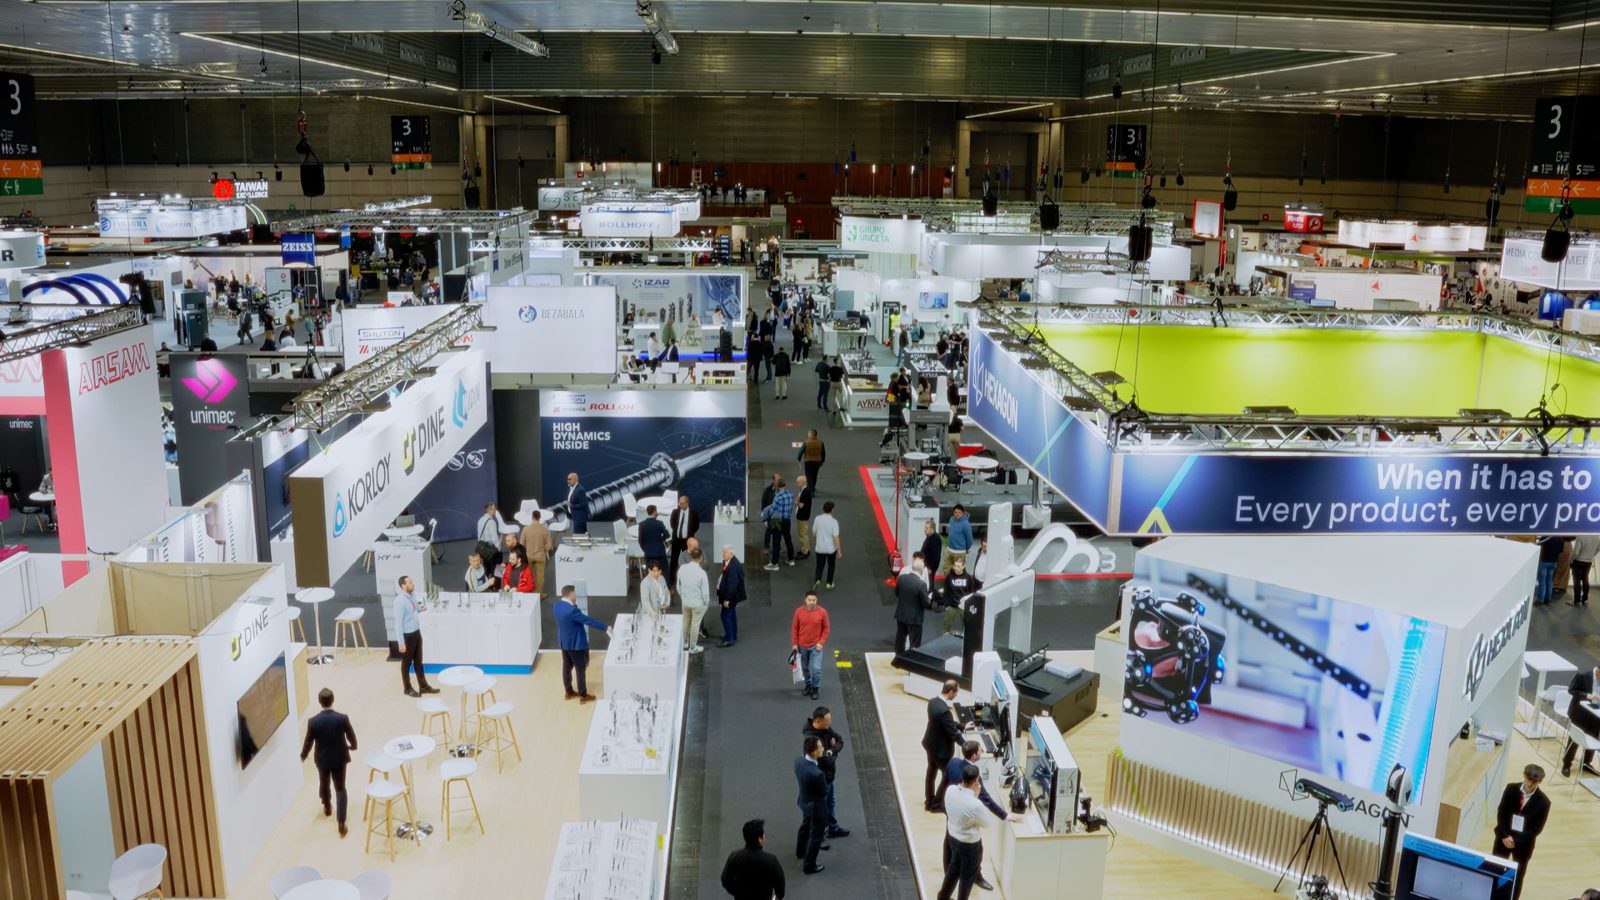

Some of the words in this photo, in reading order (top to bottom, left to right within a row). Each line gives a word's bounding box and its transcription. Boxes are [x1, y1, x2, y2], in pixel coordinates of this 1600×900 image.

[8, 79, 21, 115] 3
[402, 119, 411, 136] 3
[1548, 104, 1562, 139] 3
[1126, 128, 1136, 145] 3
[234, 181, 268, 192] TAIWAN
[282, 242, 313, 252] ZEISS
[1504, 247, 1527, 258] MEDIA
[541, 308, 585, 320] BEZABALA
[79, 342, 151, 396] ARSAM
[857, 400, 882, 409] AYMA
[984, 368, 1018, 433] HEXAGON
[9, 418, 33, 429] unimec
[418, 405, 445, 459] DINE
[552, 422, 581, 432] HIGH
[552, 431, 611, 441] DYNAMICS
[552, 440, 590, 450] INSIDE
[1377, 463, 1462, 490] When
[1470, 463, 1493, 490] it
[1499, 463, 1554, 490] has
[1561, 465, 1592, 490] to
[347, 451, 391, 522] KORLOY
[1236, 495, 1322, 529] Every
[1328, 495, 1458, 529] product,
[1466, 502, 1549, 529] every
[244, 607, 269, 647] DINE
